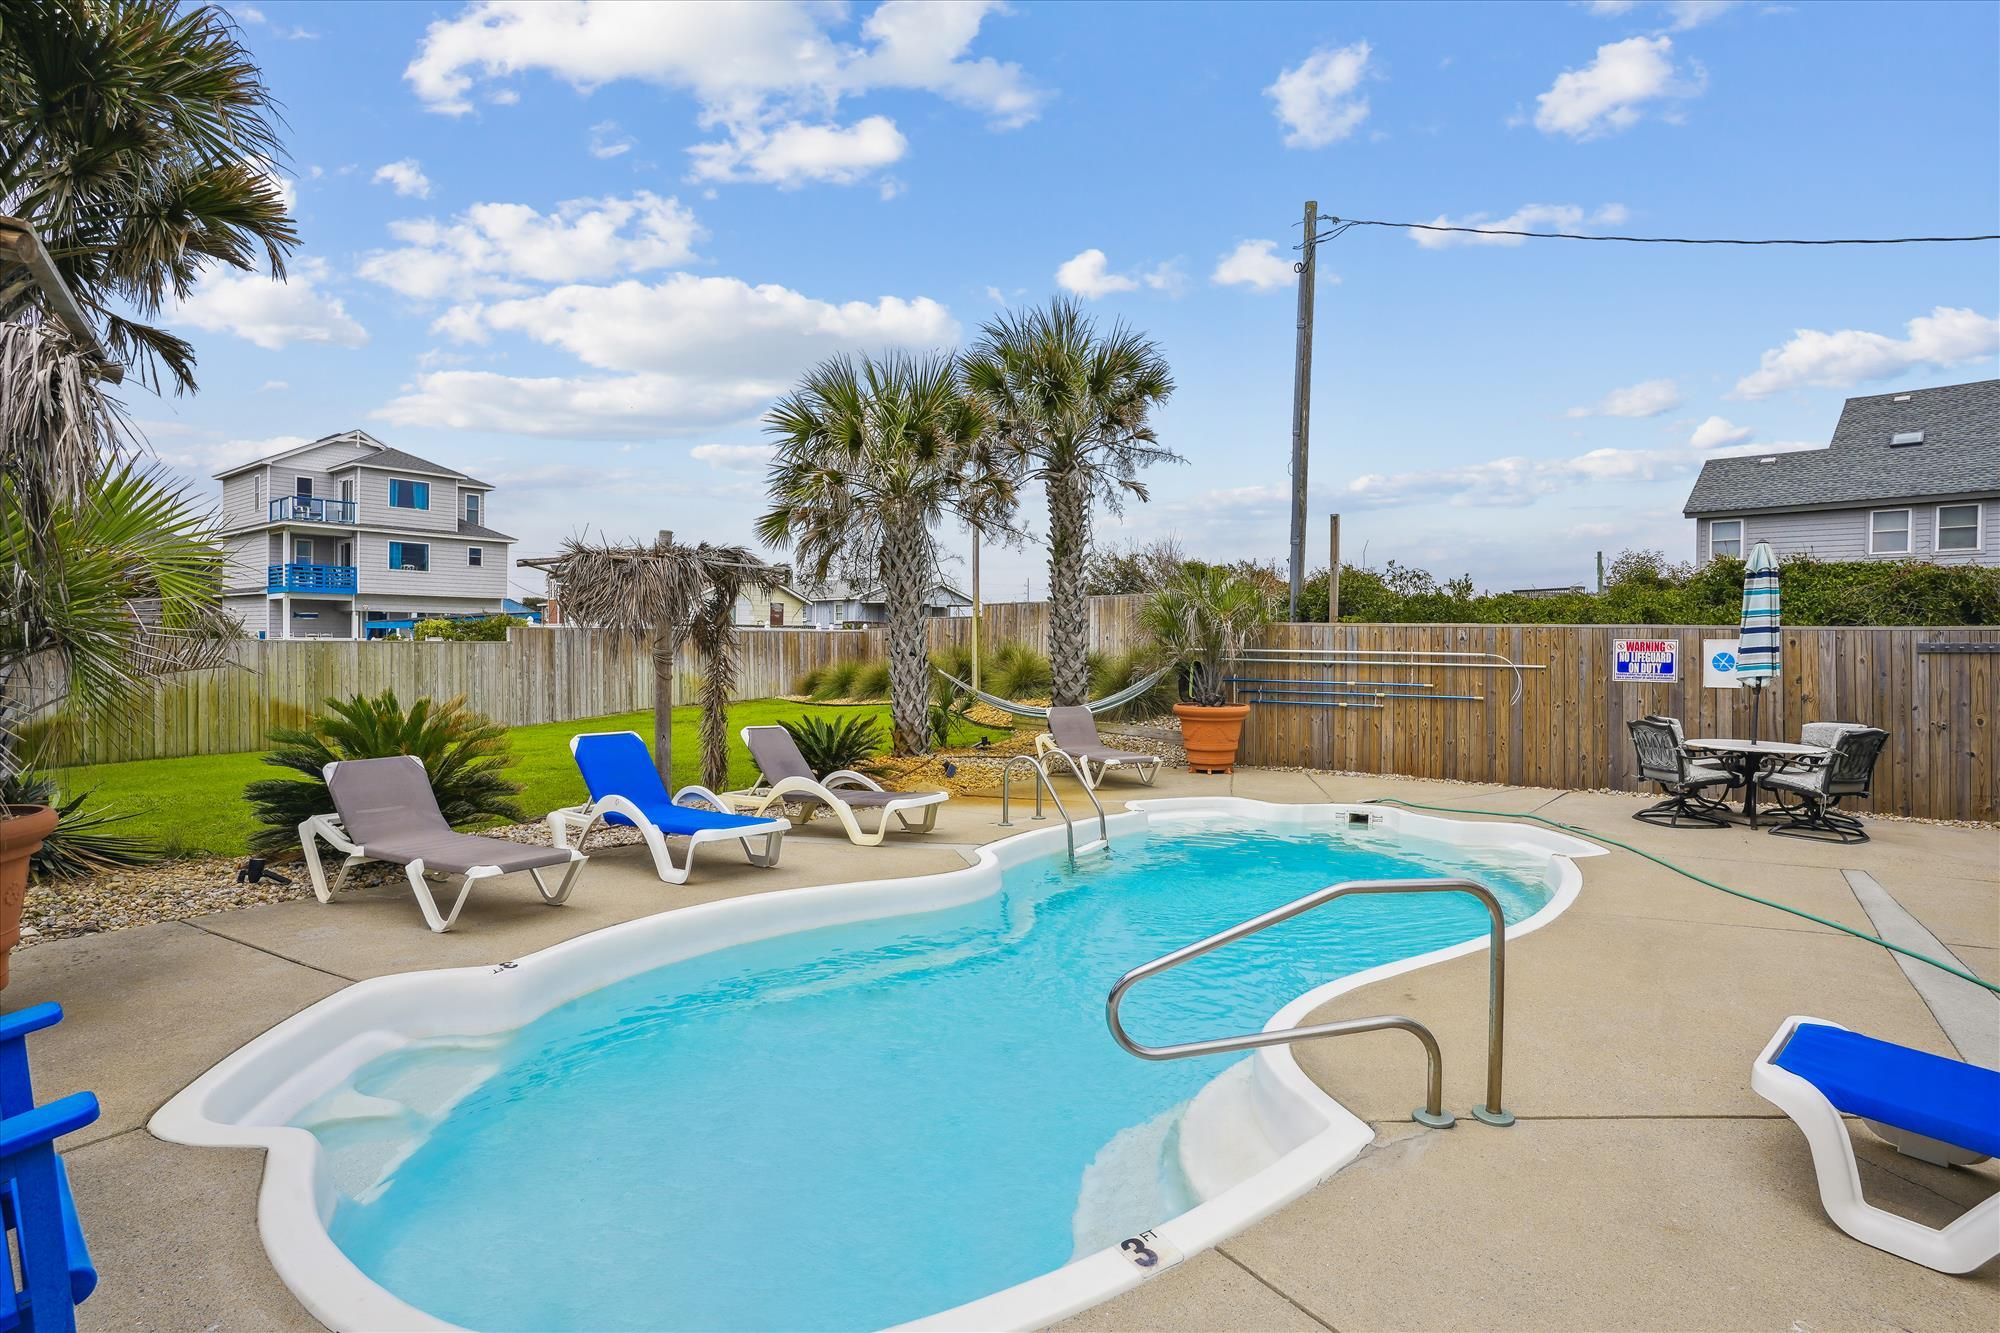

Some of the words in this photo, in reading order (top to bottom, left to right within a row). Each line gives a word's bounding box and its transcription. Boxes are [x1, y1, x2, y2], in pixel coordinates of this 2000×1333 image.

[1626, 641, 1665, 652] WARNING
[1619, 652, 1630, 662] NO
[1631, 652, 1672, 663] LIFEGUARD
[1628, 662, 1640, 673] ON
[1641, 662, 1662, 674] DUTY
[1139, 1229, 1158, 1242] FT
[1120, 1237, 1159, 1267] 3
